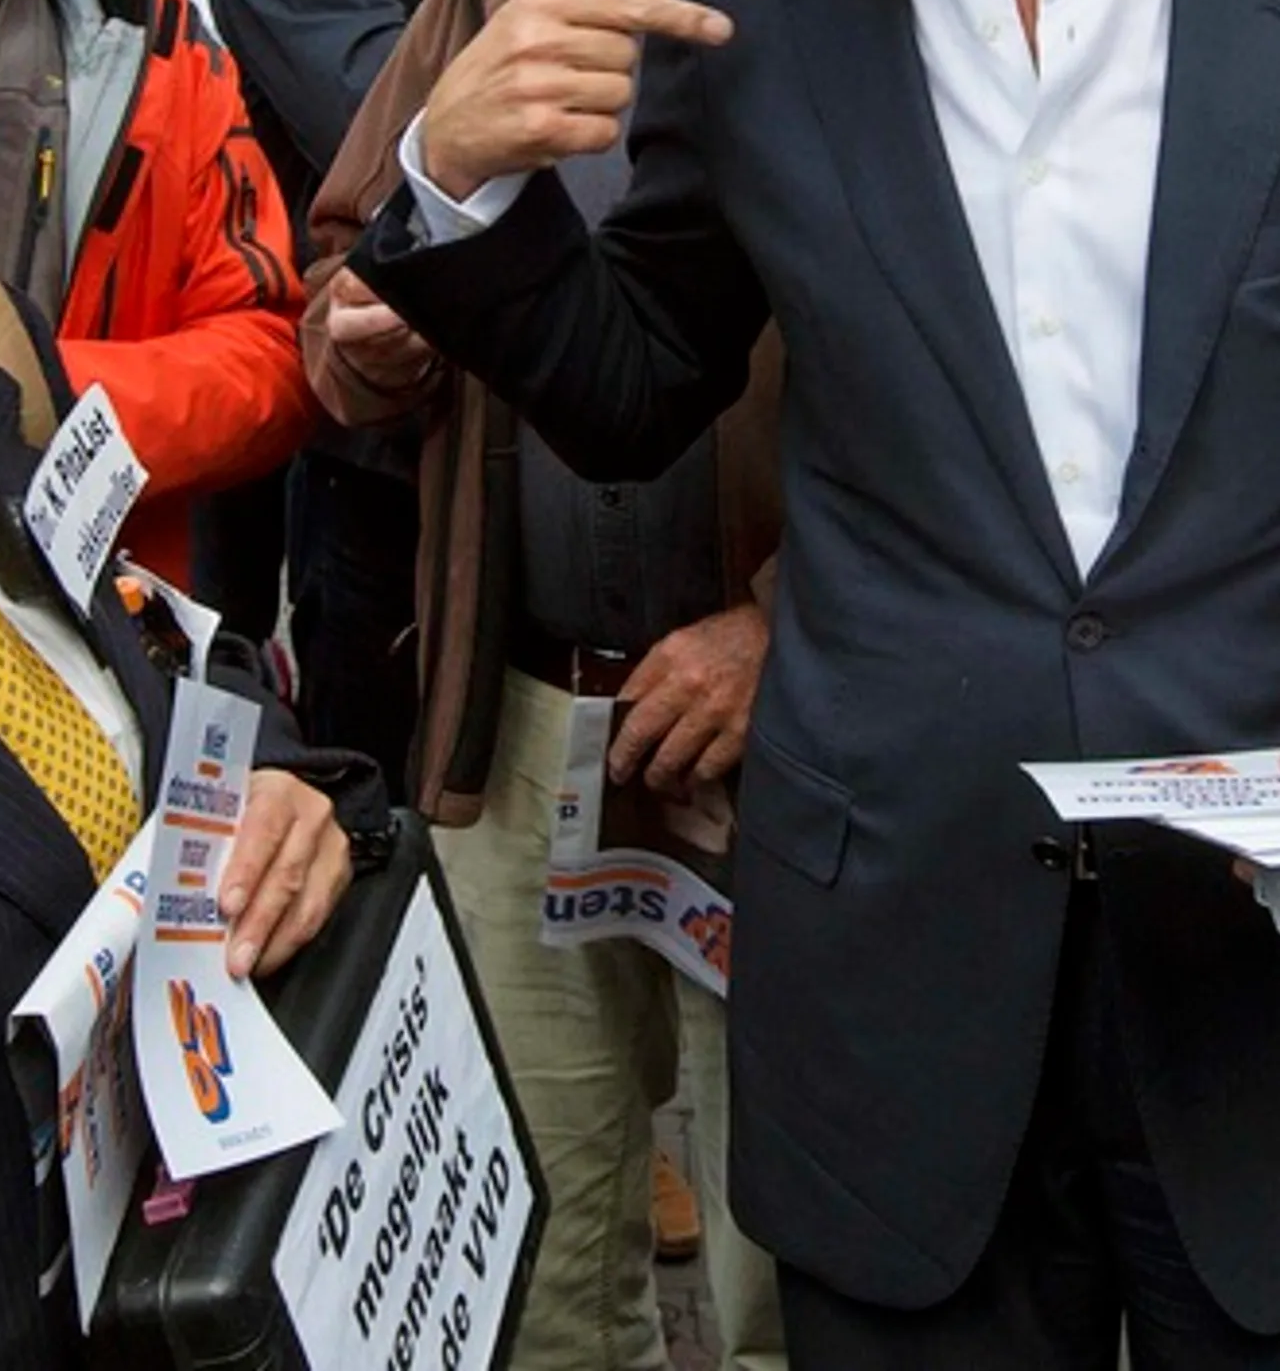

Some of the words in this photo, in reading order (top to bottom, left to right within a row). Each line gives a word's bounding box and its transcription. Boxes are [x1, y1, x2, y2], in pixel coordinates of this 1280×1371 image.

[353, 1068, 449, 1339] mogelijk
[387, 1130, 474, 1371] emaakt
[441, 1293, 471, 1371] de
[462, 1146, 509, 1279] VVD
